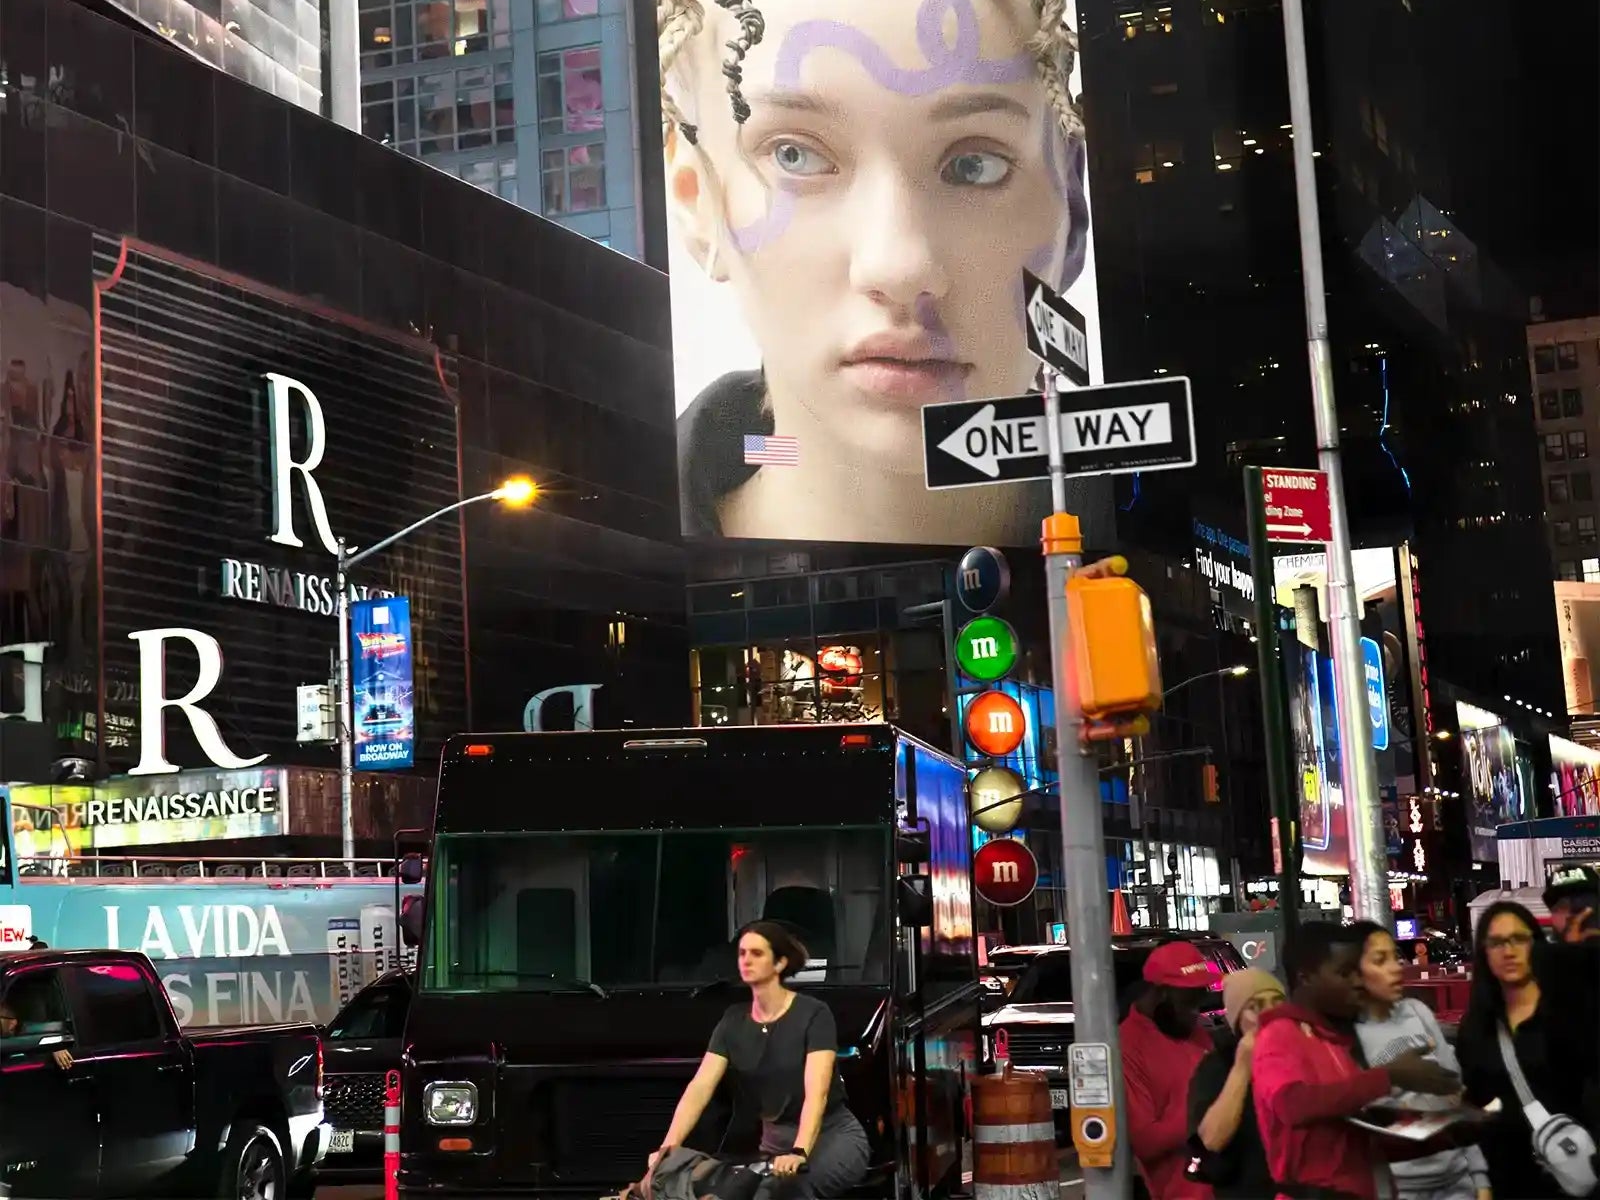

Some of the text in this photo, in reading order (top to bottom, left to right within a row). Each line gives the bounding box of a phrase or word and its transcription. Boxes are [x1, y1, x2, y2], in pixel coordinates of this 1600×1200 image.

[1034, 301, 1085, 363] ONE WAY
[965, 409, 1154, 458] ONE WAY
[265, 372, 358, 556] R
[1266, 474, 1317, 490] STANDING
[1265, 505, 1304, 519] ding Zone
[963, 568, 981, 590] m
[1196, 548, 1213, 578] Find
[1213, 557, 1230, 588] your
[1231, 561, 1255, 602] happy
[971, 636, 997, 659] m
[128, 627, 272, 776] R
[989, 711, 1013, 733] m
[359, 750, 409, 762] BROADWAY
[365, 742, 403, 753] NOW ON
[88, 787, 275, 825] RENAISSANCE
[992, 860, 1019, 883] m
[102, 904, 292, 959] LA VIDA
[206, 971, 318, 1025] FINA
